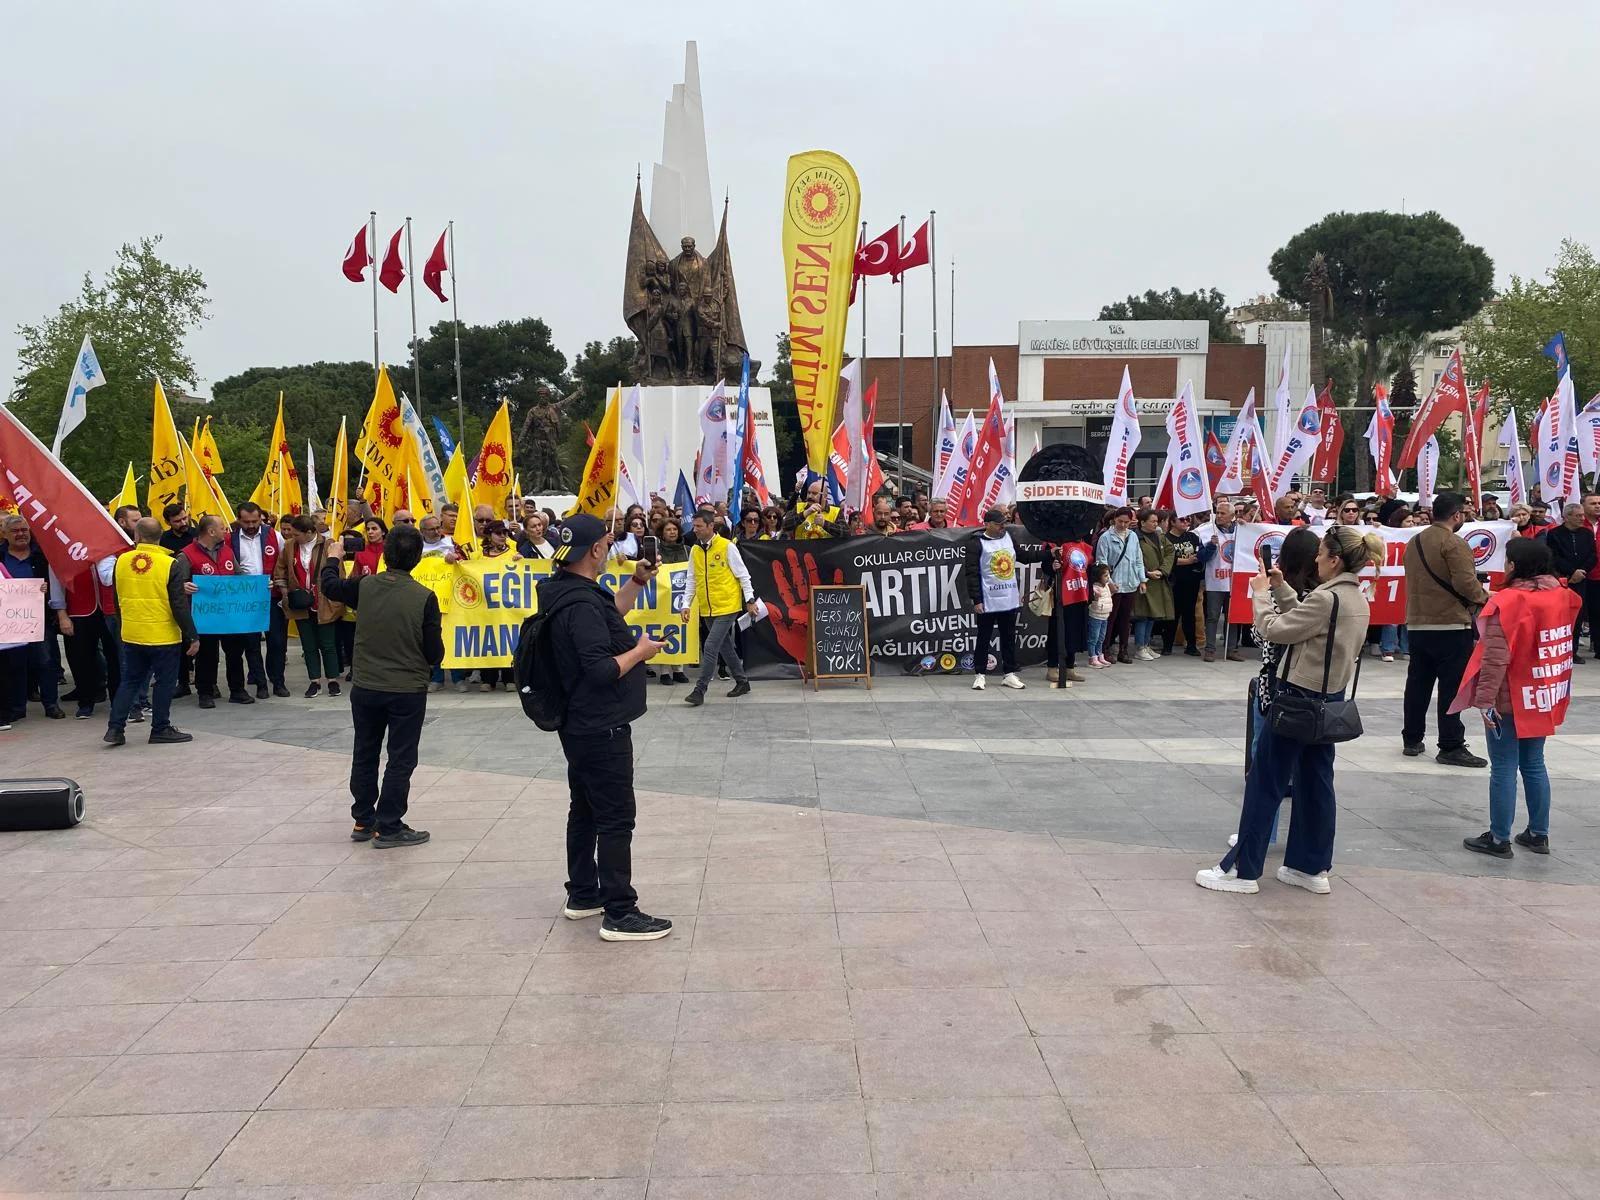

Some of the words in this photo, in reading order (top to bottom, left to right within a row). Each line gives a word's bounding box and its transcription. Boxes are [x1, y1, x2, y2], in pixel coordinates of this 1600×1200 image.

[1031, 338, 1070, 351] MANİSA
[1073, 336, 1140, 352] BÜYÜKŞEHİR
[1141, 335, 1201, 350] BELEDİYESİ
[1023, 484, 1079, 499] ŞİDDETE
[1082, 487, 1103, 500] HAYIR
[854, 551, 912, 567] OKULLAR
[860, 563, 963, 617] ARTIK
[6, 608, 37, 619] OKUL
[816, 610, 841, 622] DERS
[1540, 624, 1572, 642] EMEK
[870, 638, 939, 657] AĞLIKLI
[942, 632, 1000, 653] EĞİTM
[1539, 640, 1573, 659] EYLEM
[826, 653, 861, 672] YOK!
